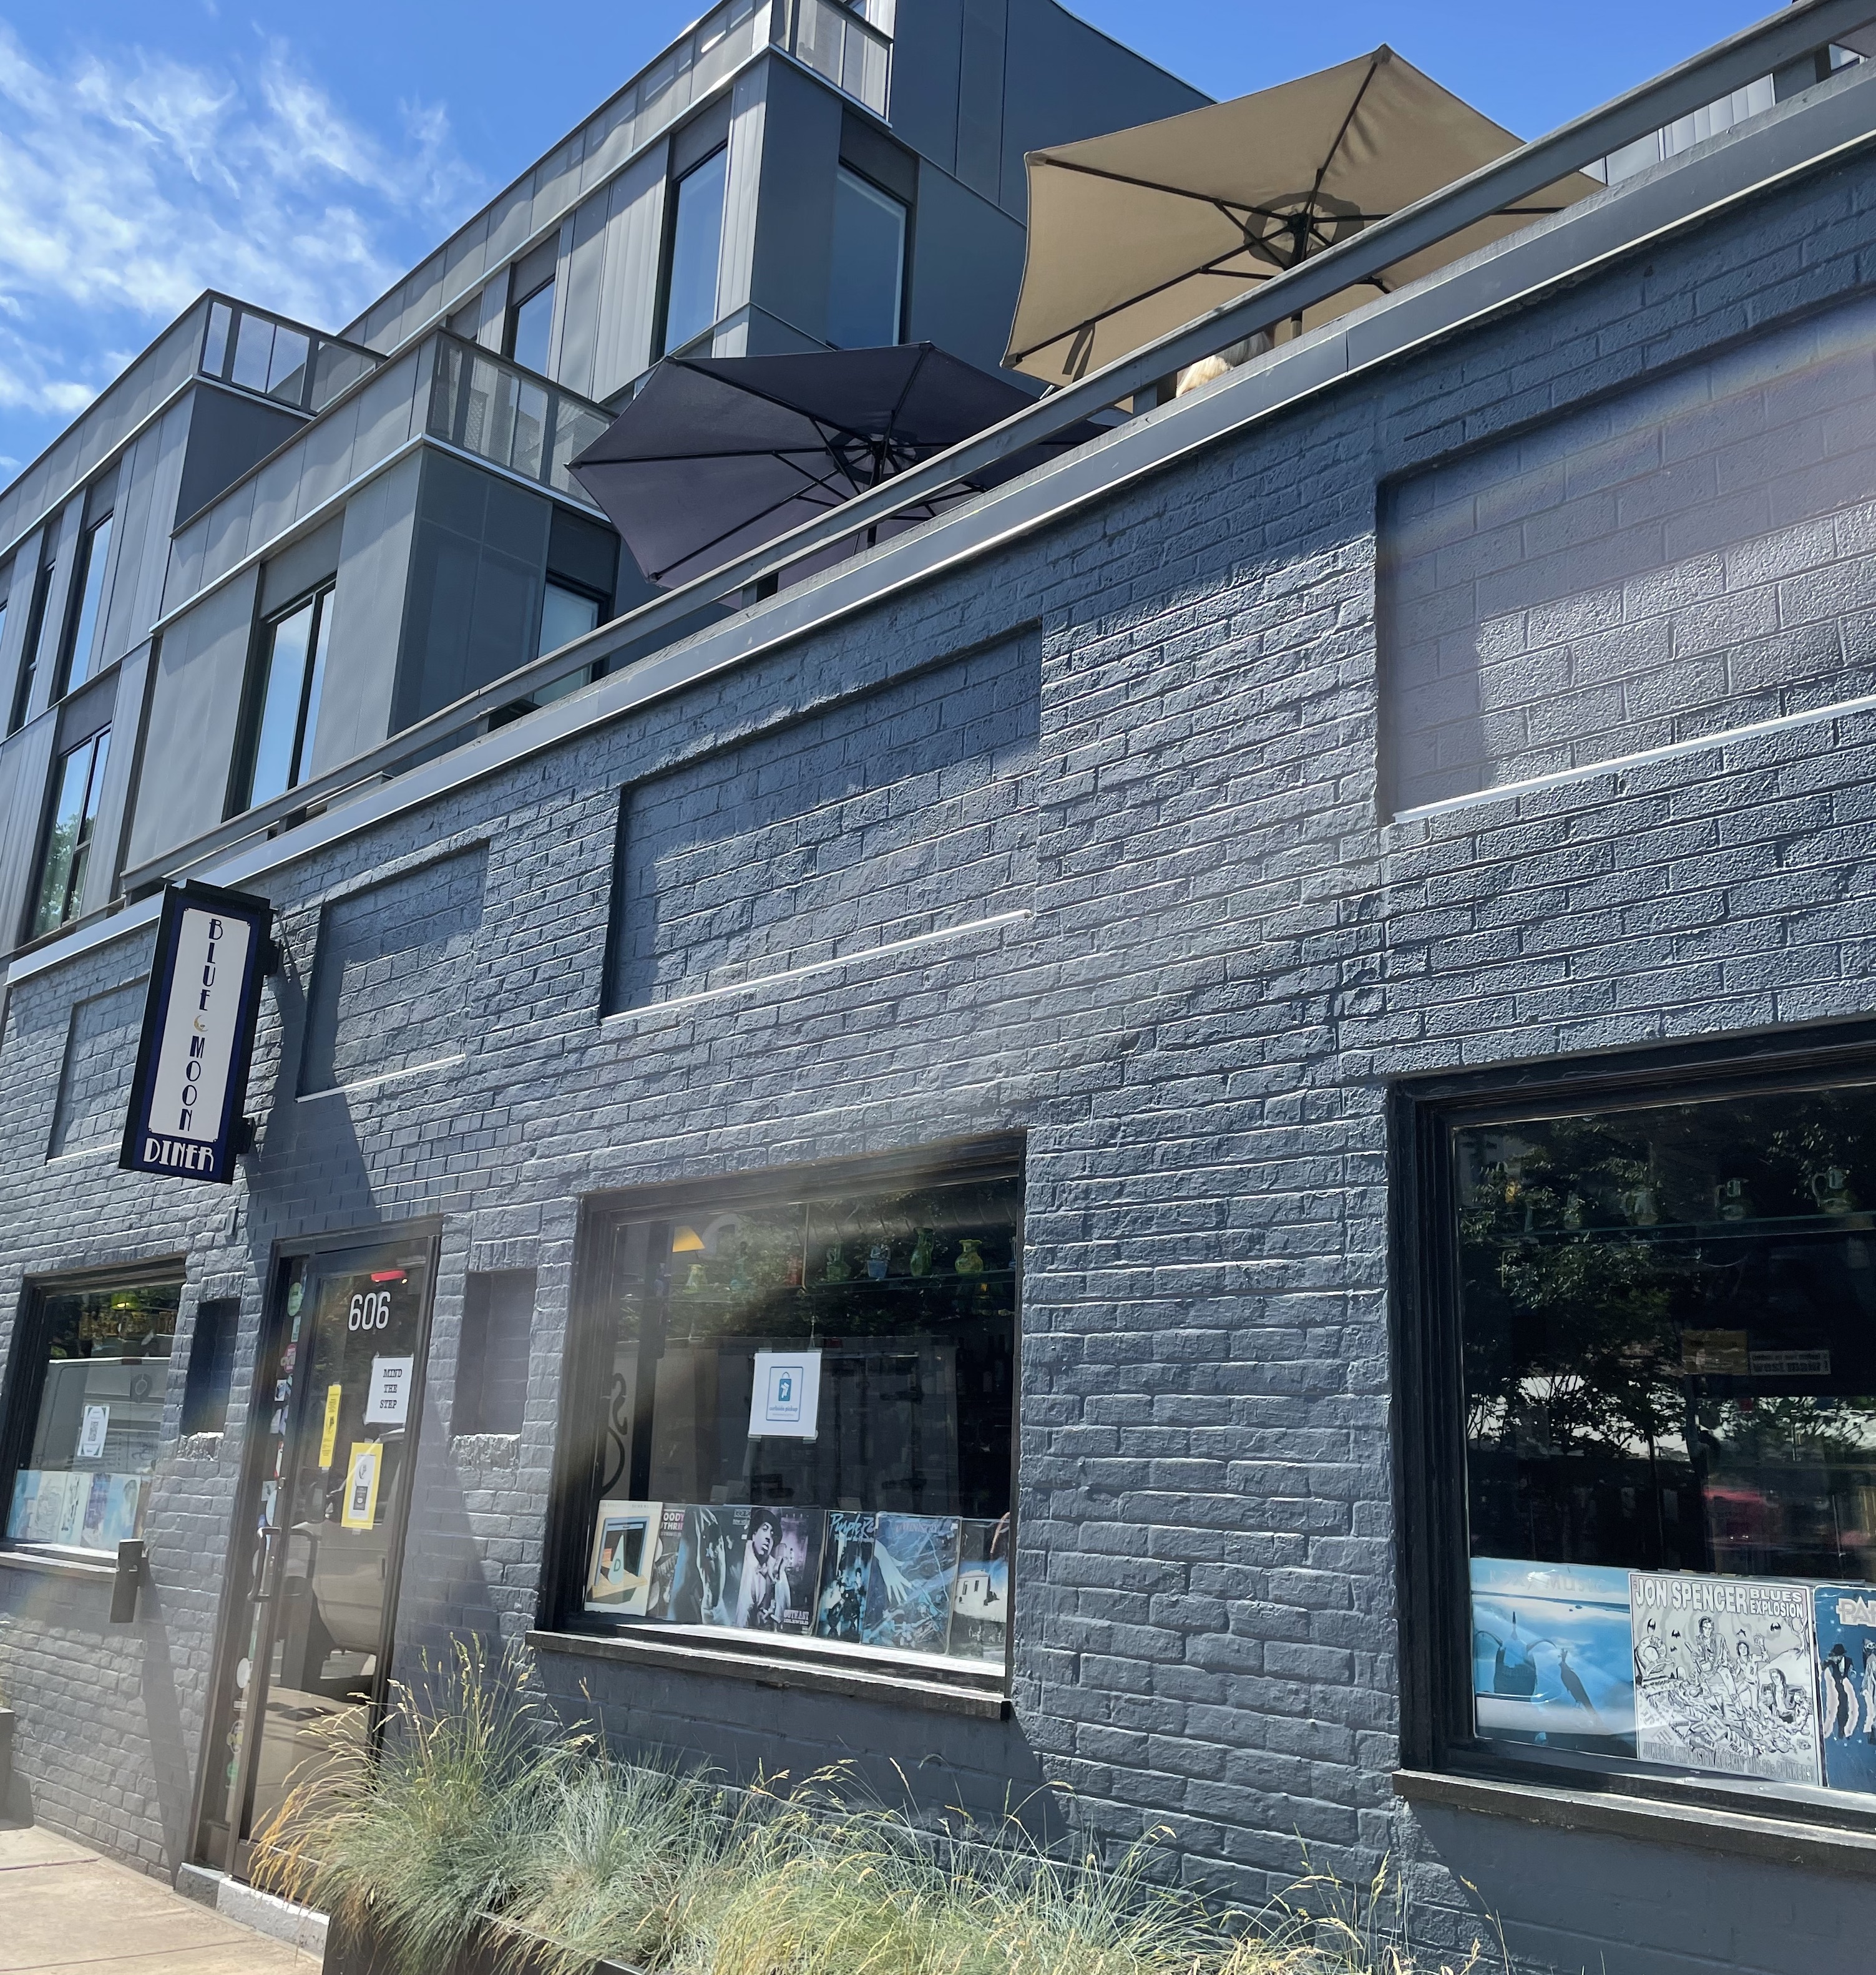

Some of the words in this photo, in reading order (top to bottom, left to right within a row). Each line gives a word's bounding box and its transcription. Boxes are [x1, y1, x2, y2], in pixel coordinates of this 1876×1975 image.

[198, 918, 223, 1012] BLUE
[178, 1035, 206, 1132] MOON
[143, 1137, 215, 1172] DINER
[348, 1291, 391, 1331] 606
[383, 1368, 403, 1378] MIND
[383, 1384, 398, 1393] THE
[379, 1400, 397, 1409] STEP
[613, 1559, 622, 1572] D
[1635, 1578, 1667, 1608] JON
[1671, 1581, 1747, 1614] SPENCER
[1749, 1587, 1803, 1603] BLUES
[1749, 1599, 1804, 1618] EXPLOSION
